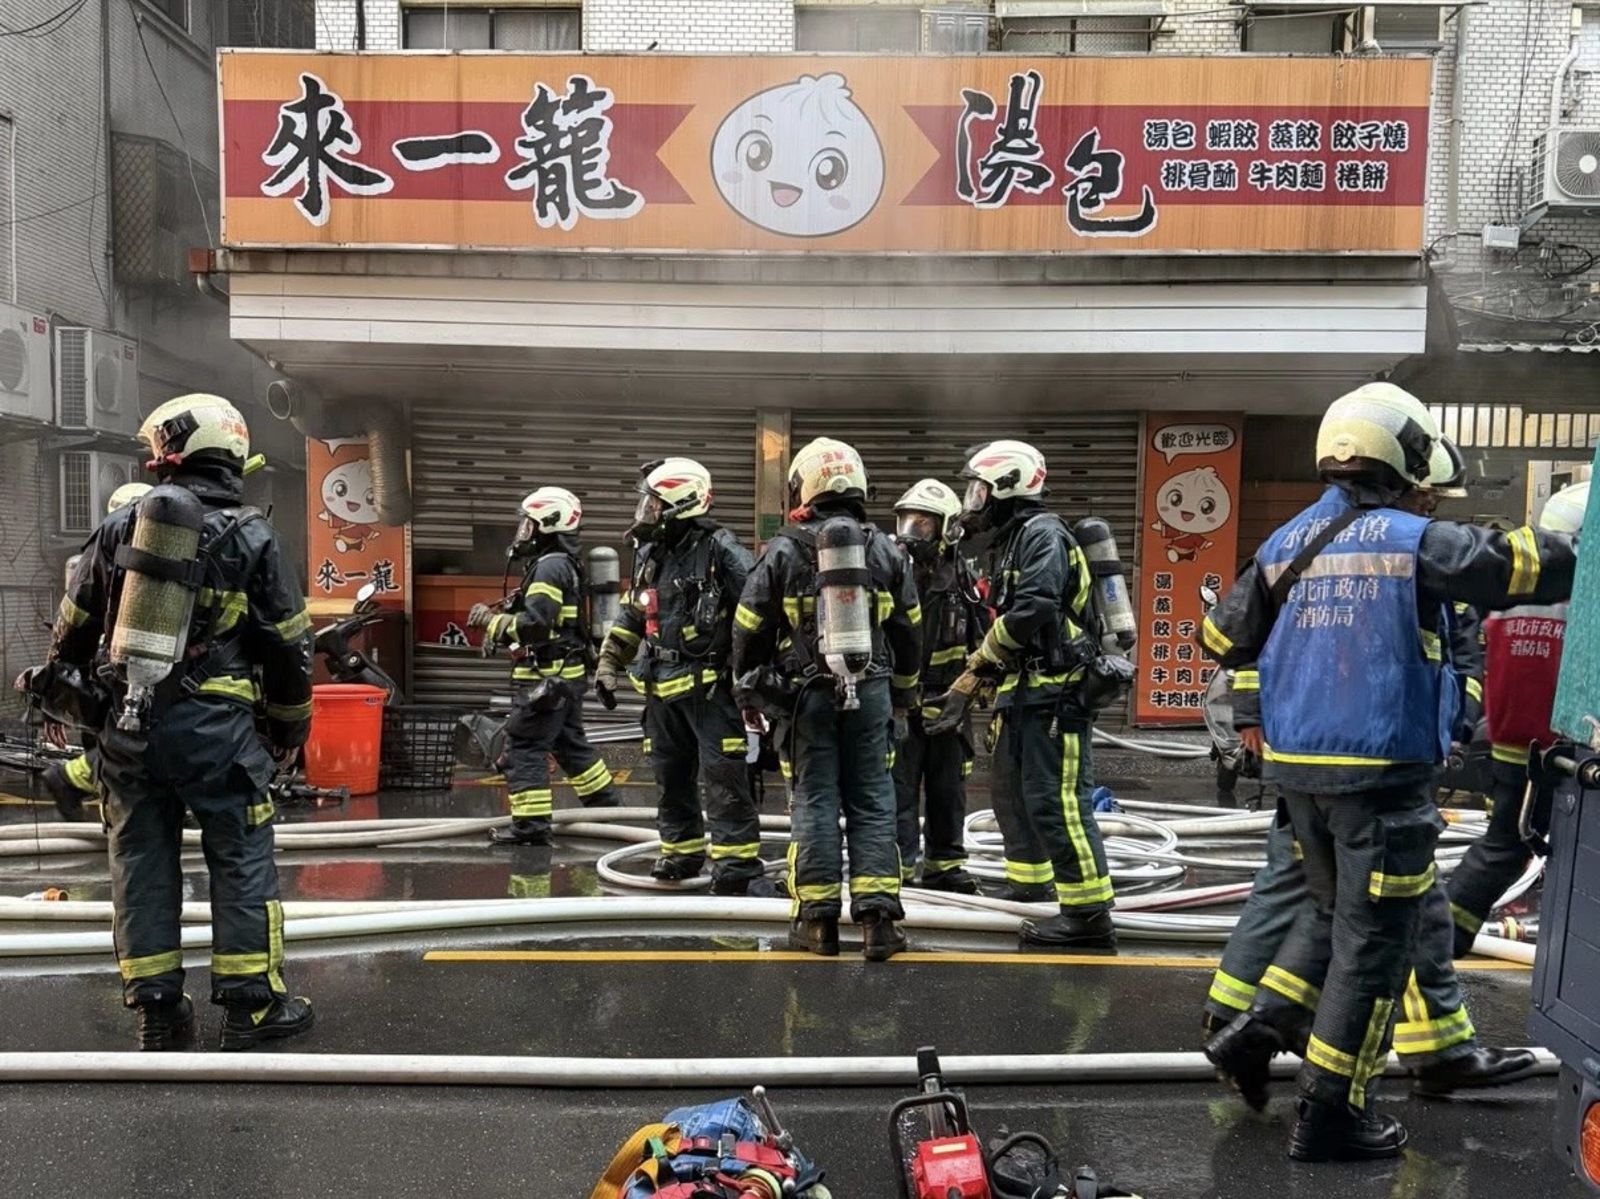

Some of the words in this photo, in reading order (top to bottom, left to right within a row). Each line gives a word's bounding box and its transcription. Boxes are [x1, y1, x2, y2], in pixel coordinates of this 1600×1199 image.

[1144, 120, 1196, 150] 湯包
[1207, 120, 1259, 150] 蝦餃
[1269, 120, 1321, 150] 蒸餃
[1332, 120, 1408, 151] 餃子燒
[262, 73, 644, 229] 來一籠
[956, 69, 1157, 237] 湯包
[1249, 160, 1325, 191] 牛肉麵
[1336, 160, 1388, 191] 捲餅
[1161, 430, 1229, 449] 歡迎光臨
[316, 559, 400, 592] 來一籠
[1296, 604, 1354, 629] 消防局
[1151, 689, 1206, 708] 牛肉捲
